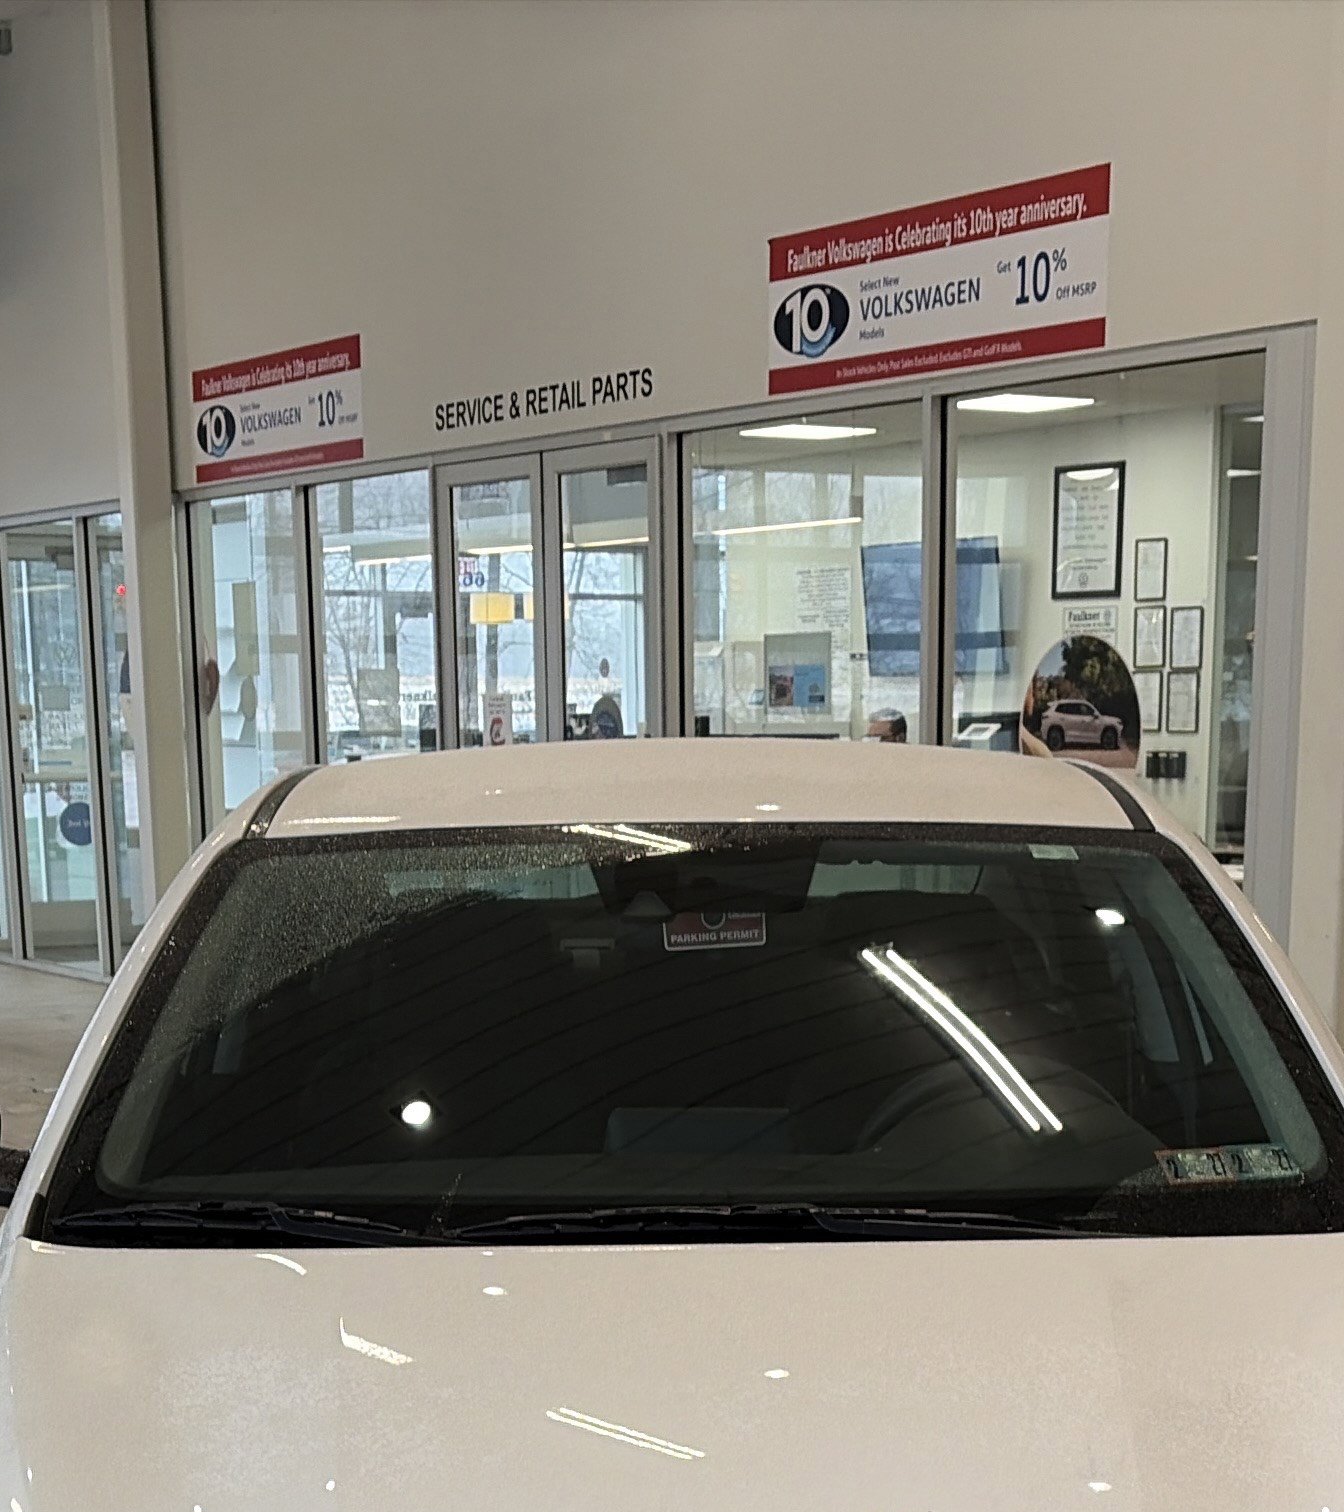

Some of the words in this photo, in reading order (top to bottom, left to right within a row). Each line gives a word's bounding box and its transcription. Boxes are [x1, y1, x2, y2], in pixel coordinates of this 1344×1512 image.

[787, 246, 826, 273] Faulkner
[827, 235, 883, 264] Volkswagen
[885, 227, 894, 253] is
[895, 217, 952, 248] Celebrating
[969, 206, 994, 236] 10th
[995, 206, 1019, 237] year
[1020, 193, 1087, 221] anniversary.
[860, 279, 881, 293] Select
[883, 276, 900, 288] New
[1072, 281, 1097, 298] MSRP
[859, 277, 981, 322] VOLKSWAGEN
[859, 327, 885, 341] Models
[435, 394, 504, 431] SERVICE
[509, 391, 521, 419] &
[526, 380, 586, 417] RETAIL
[592, 368, 653, 405] PARTS
[240, 406, 301, 434] VOLKSWAGEN
[670, 932, 717, 944] PARKING
[720, 928, 759, 940] PERMIT
